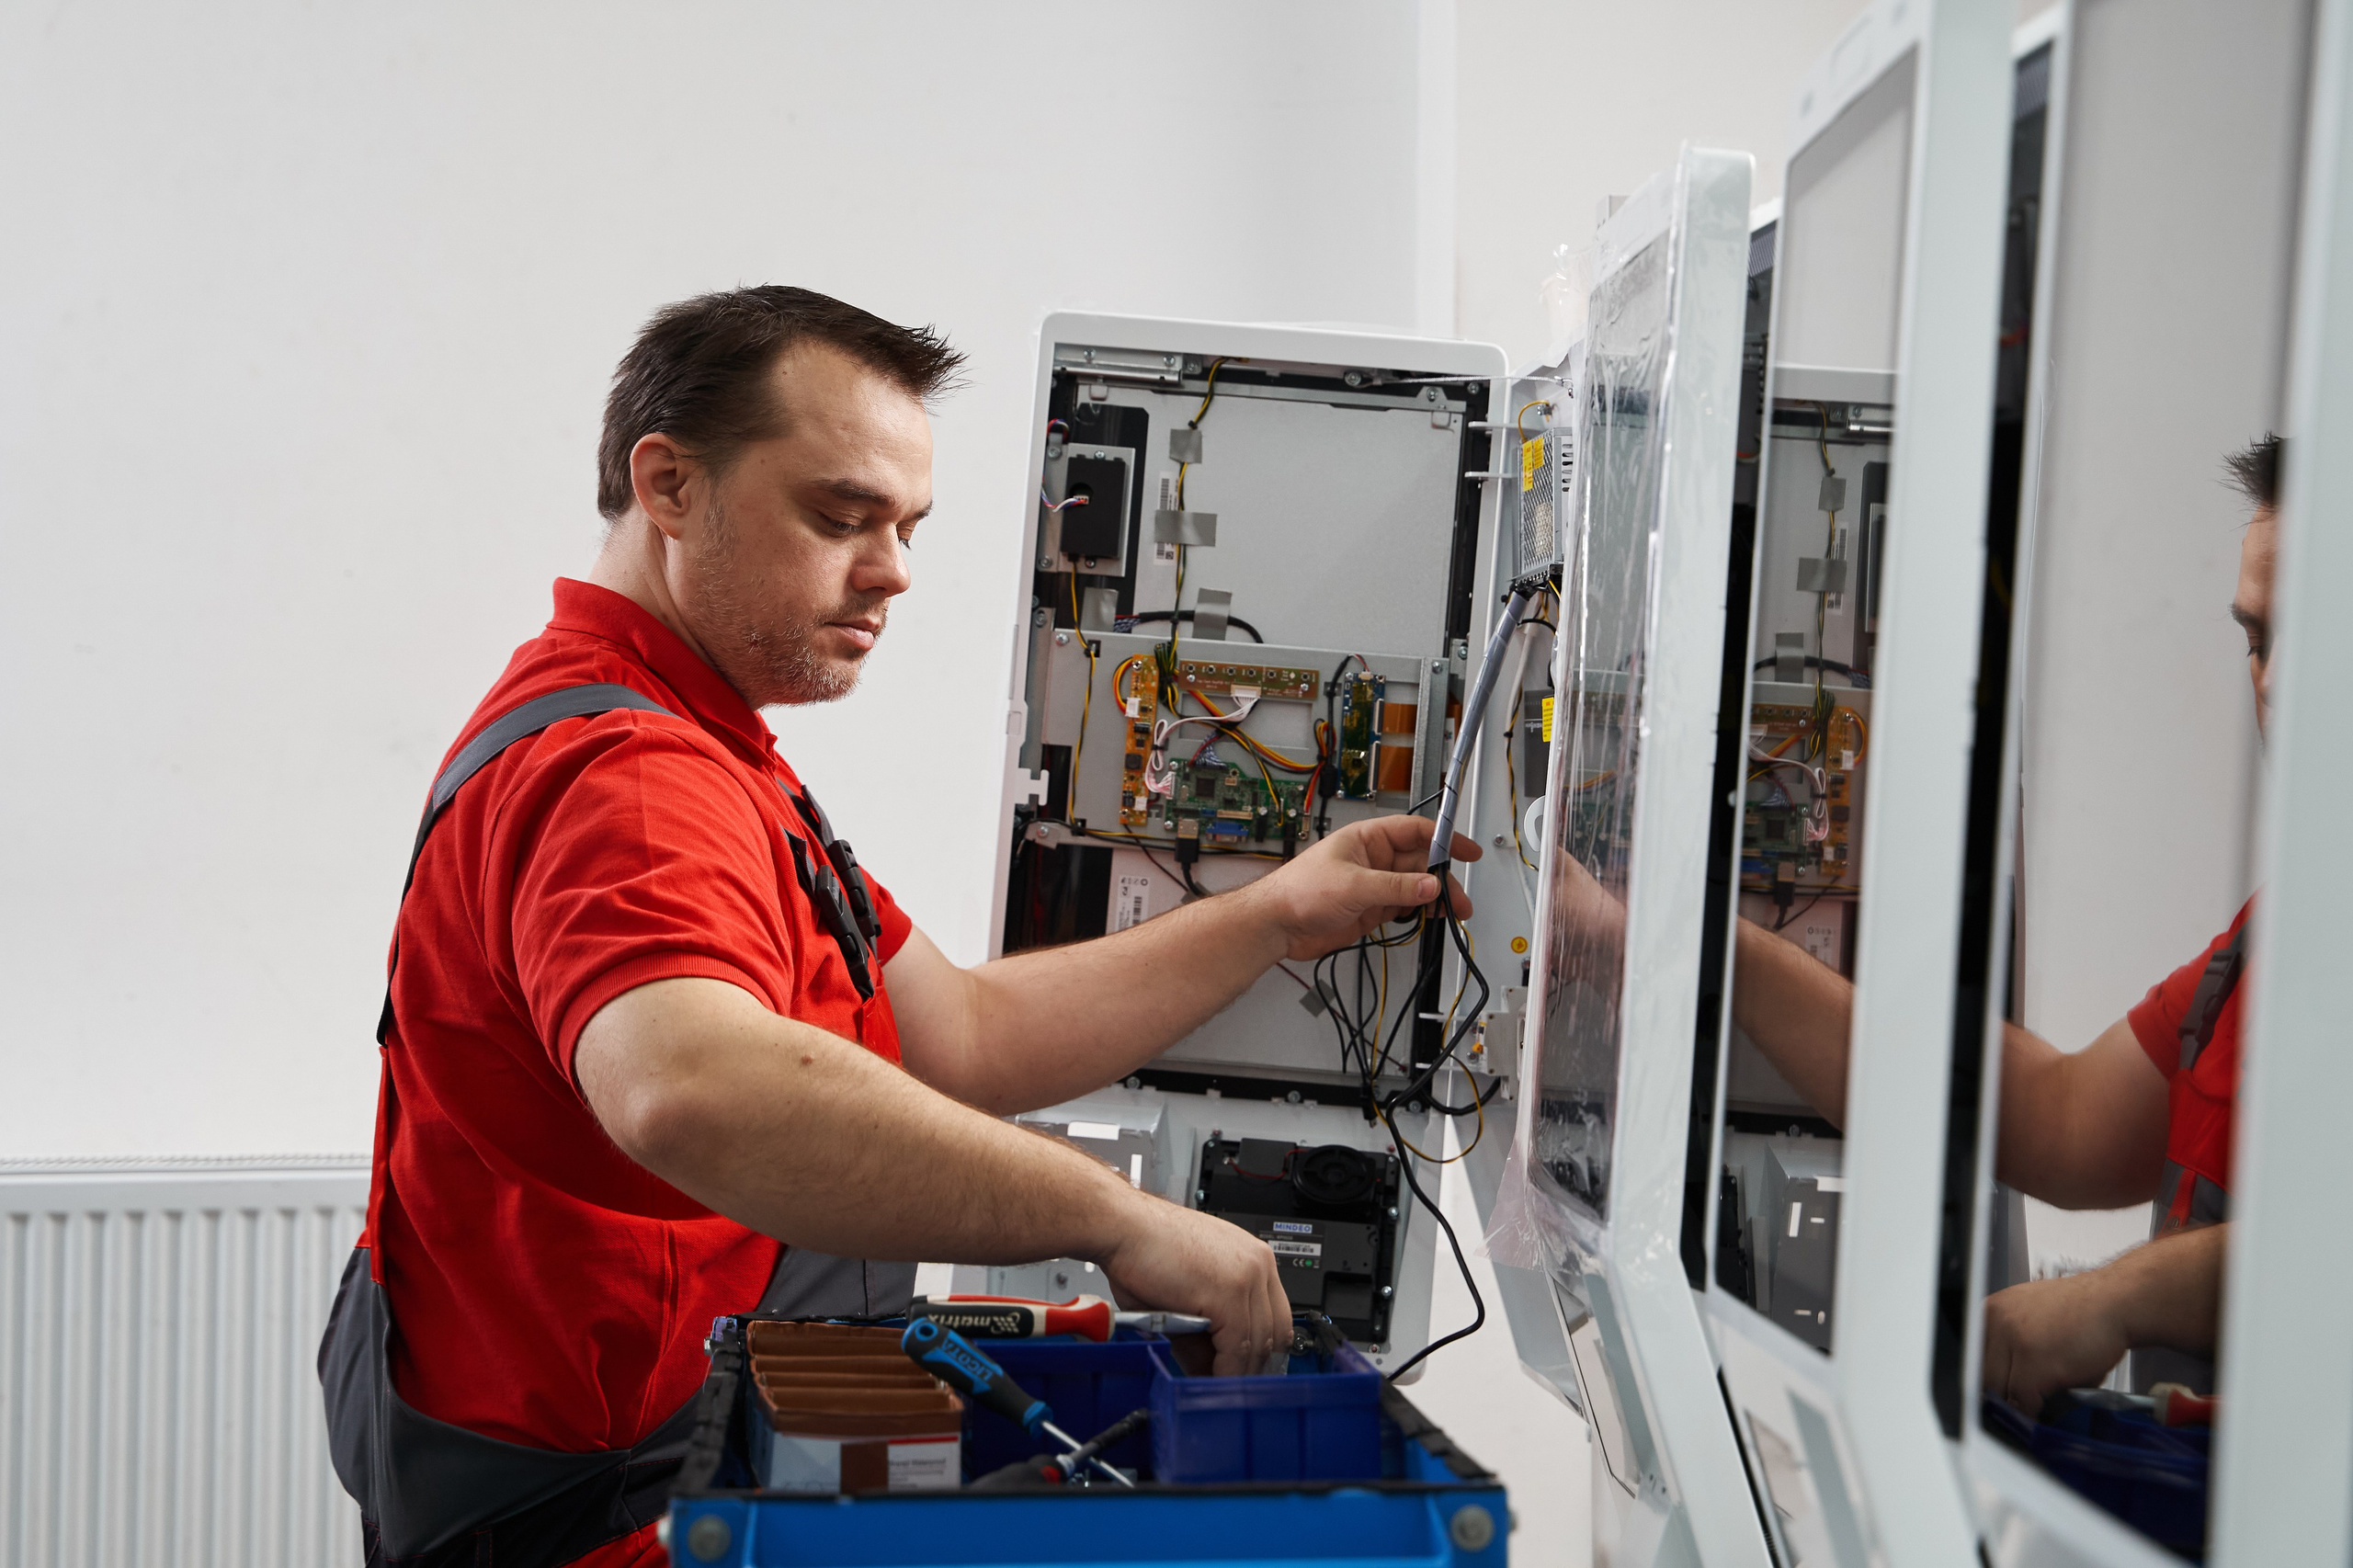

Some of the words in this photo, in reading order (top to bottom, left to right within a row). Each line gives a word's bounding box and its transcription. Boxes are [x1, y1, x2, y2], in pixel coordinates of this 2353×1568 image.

[1274, 1222, 1312, 1233] MINDEO
[927, 1313, 992, 1329] matrix
[940, 1337, 994, 1381] LICOTA
